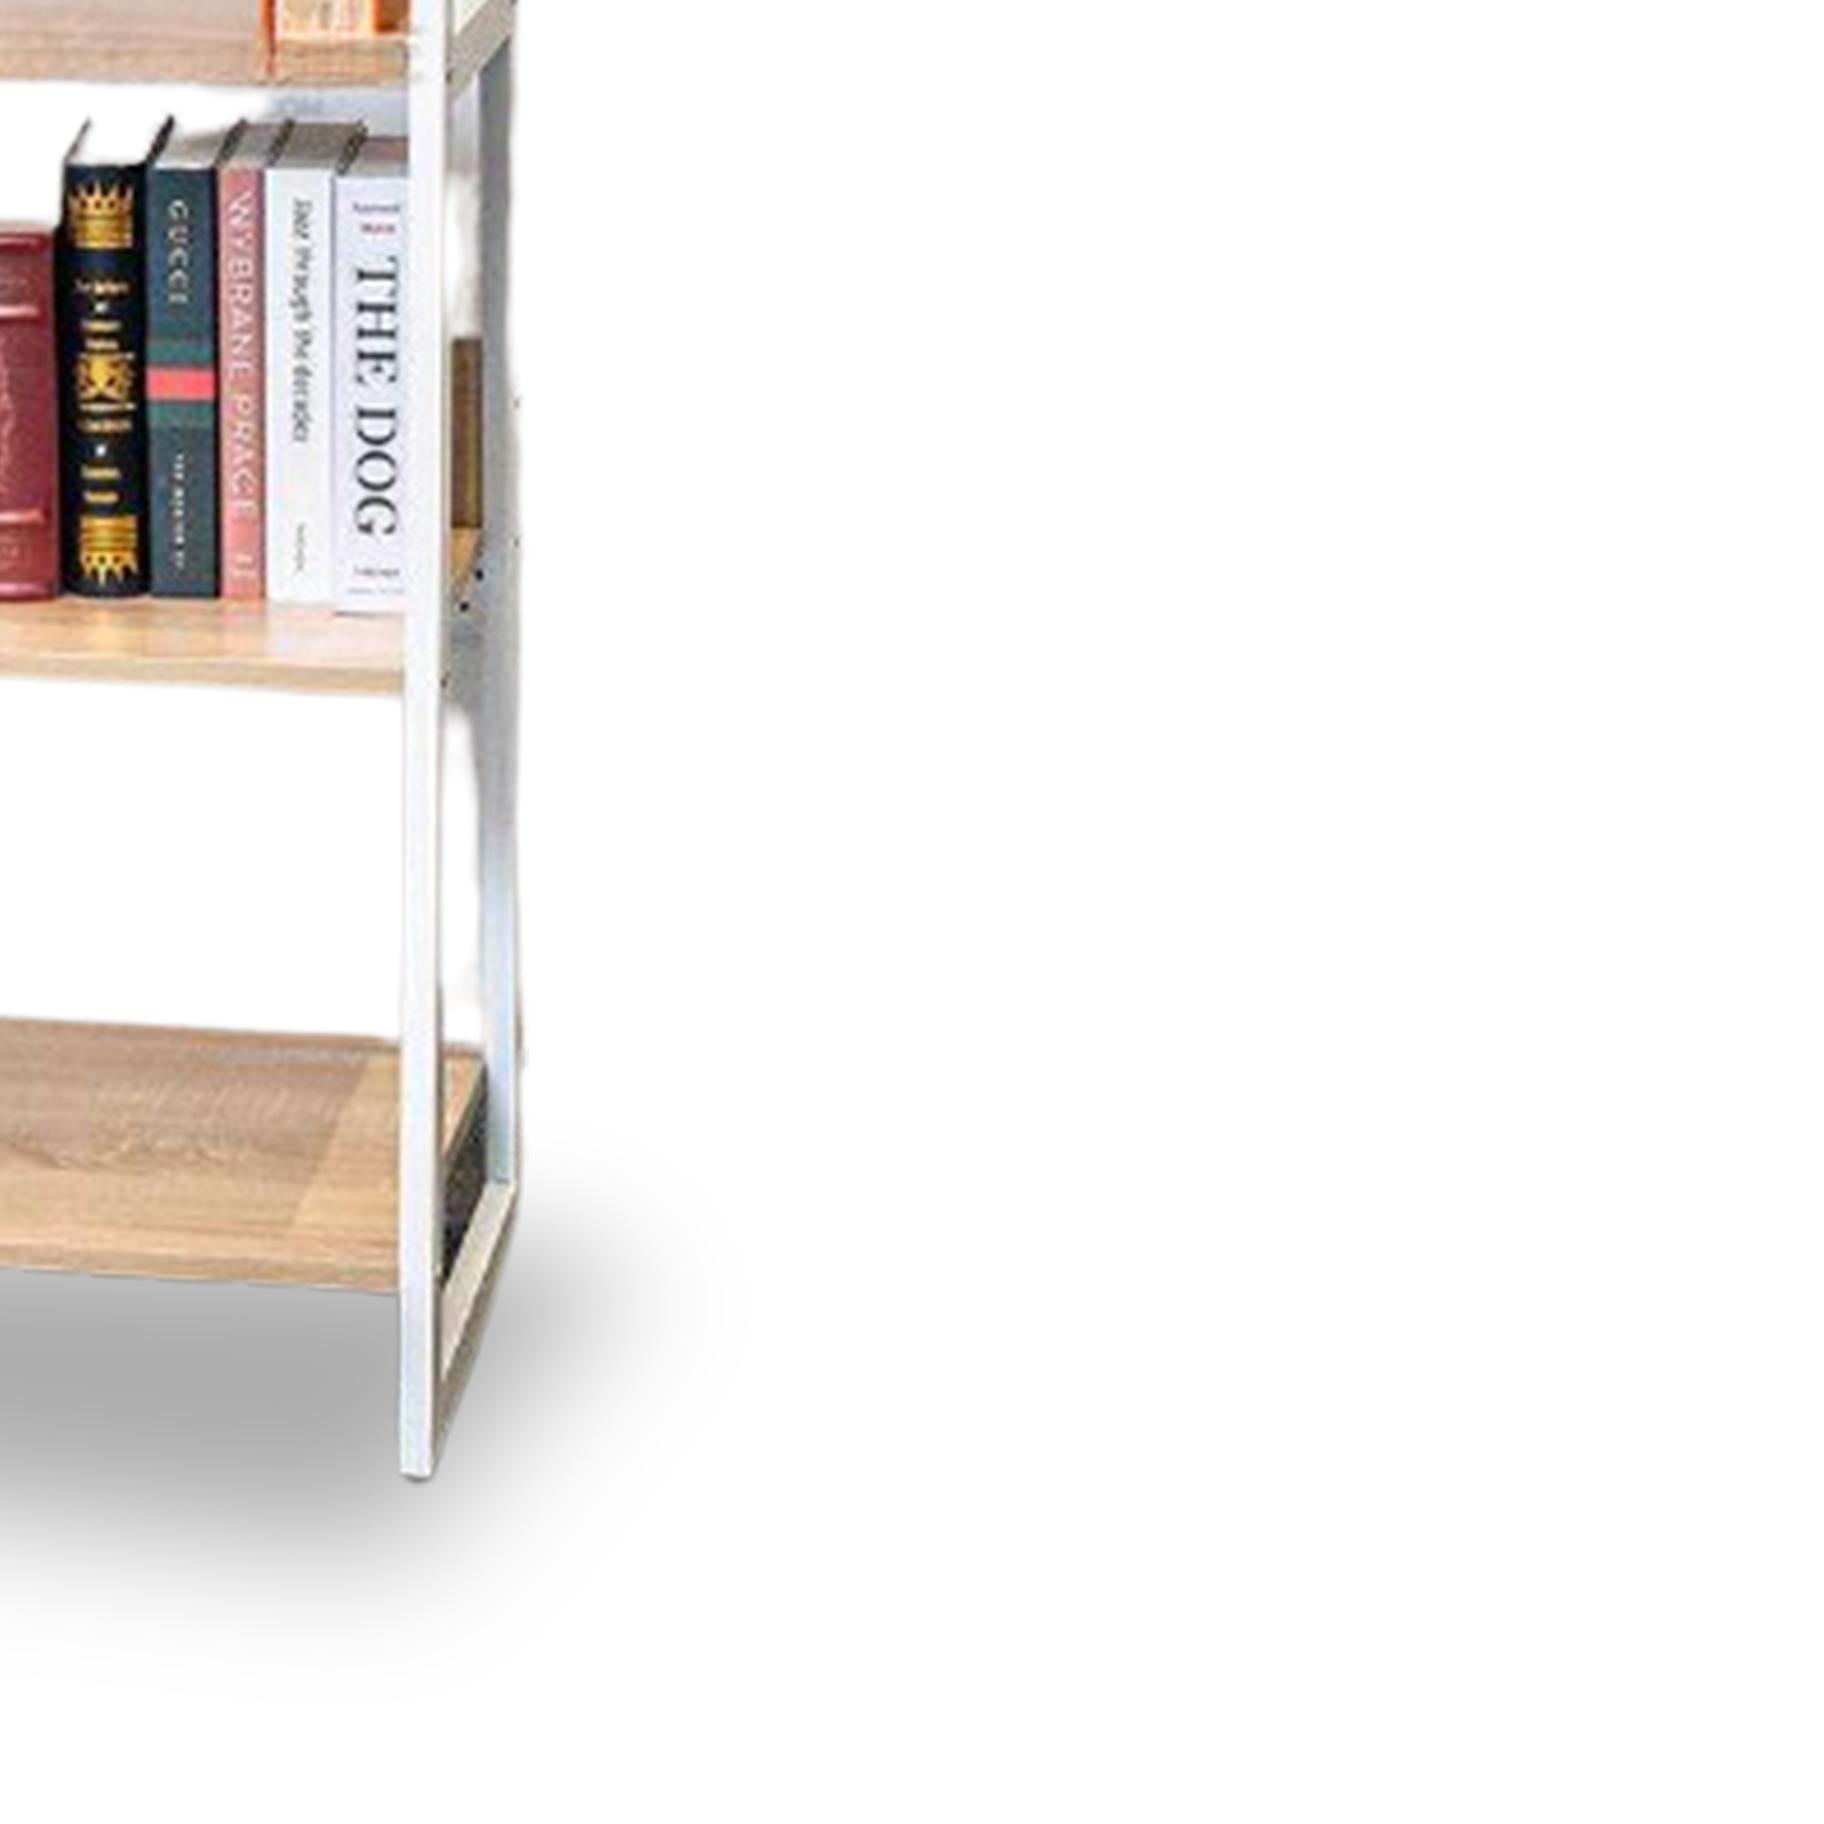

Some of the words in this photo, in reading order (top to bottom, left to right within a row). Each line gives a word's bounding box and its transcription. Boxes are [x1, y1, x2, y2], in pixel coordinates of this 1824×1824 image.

[168, 199, 189, 304] GUCCI
[226, 190, 258, 381] WYBRANE
[288, 245, 314, 323] through
[292, 328, 314, 360] the
[354, 255, 398, 384] THE
[230, 393, 259, 518] PRACE
[290, 364, 315, 444] decades
[353, 407, 399, 537] DOG
